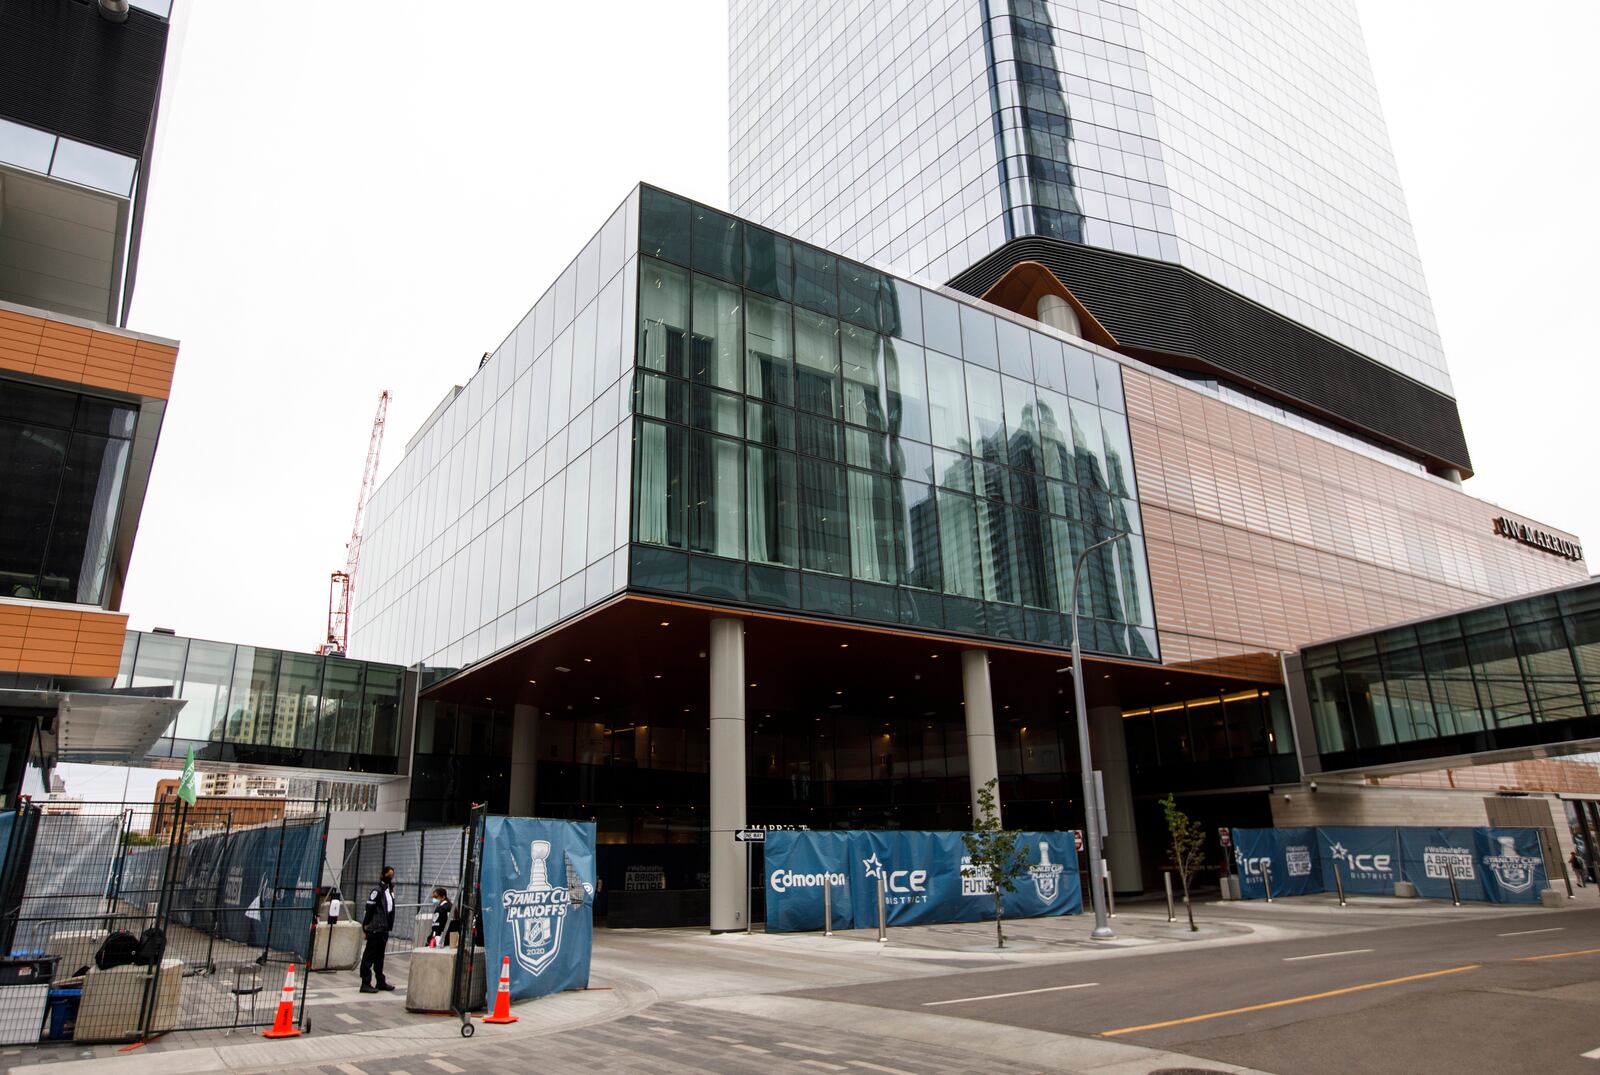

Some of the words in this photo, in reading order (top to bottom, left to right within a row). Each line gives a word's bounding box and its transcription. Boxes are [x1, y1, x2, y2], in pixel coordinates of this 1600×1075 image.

[1500, 516, 1520, 540] JW
[1521, 525, 1583, 560] MARRIOTT
[1426, 855, 1434, 864] A
[1435, 855, 1471, 866] BRIGHT
[1483, 856, 1520, 865] STANLEY
[1520, 856, 1540, 864] CUP
[634, 873, 663, 882] BRIGHT
[1427, 865, 1473, 878] FUTURE
[770, 869, 846, 893] Edmonton
[503, 891, 551, 906] STANLEY
[509, 903, 566, 919] PLAYOFFS
[526, 948, 546, 957] 2020
